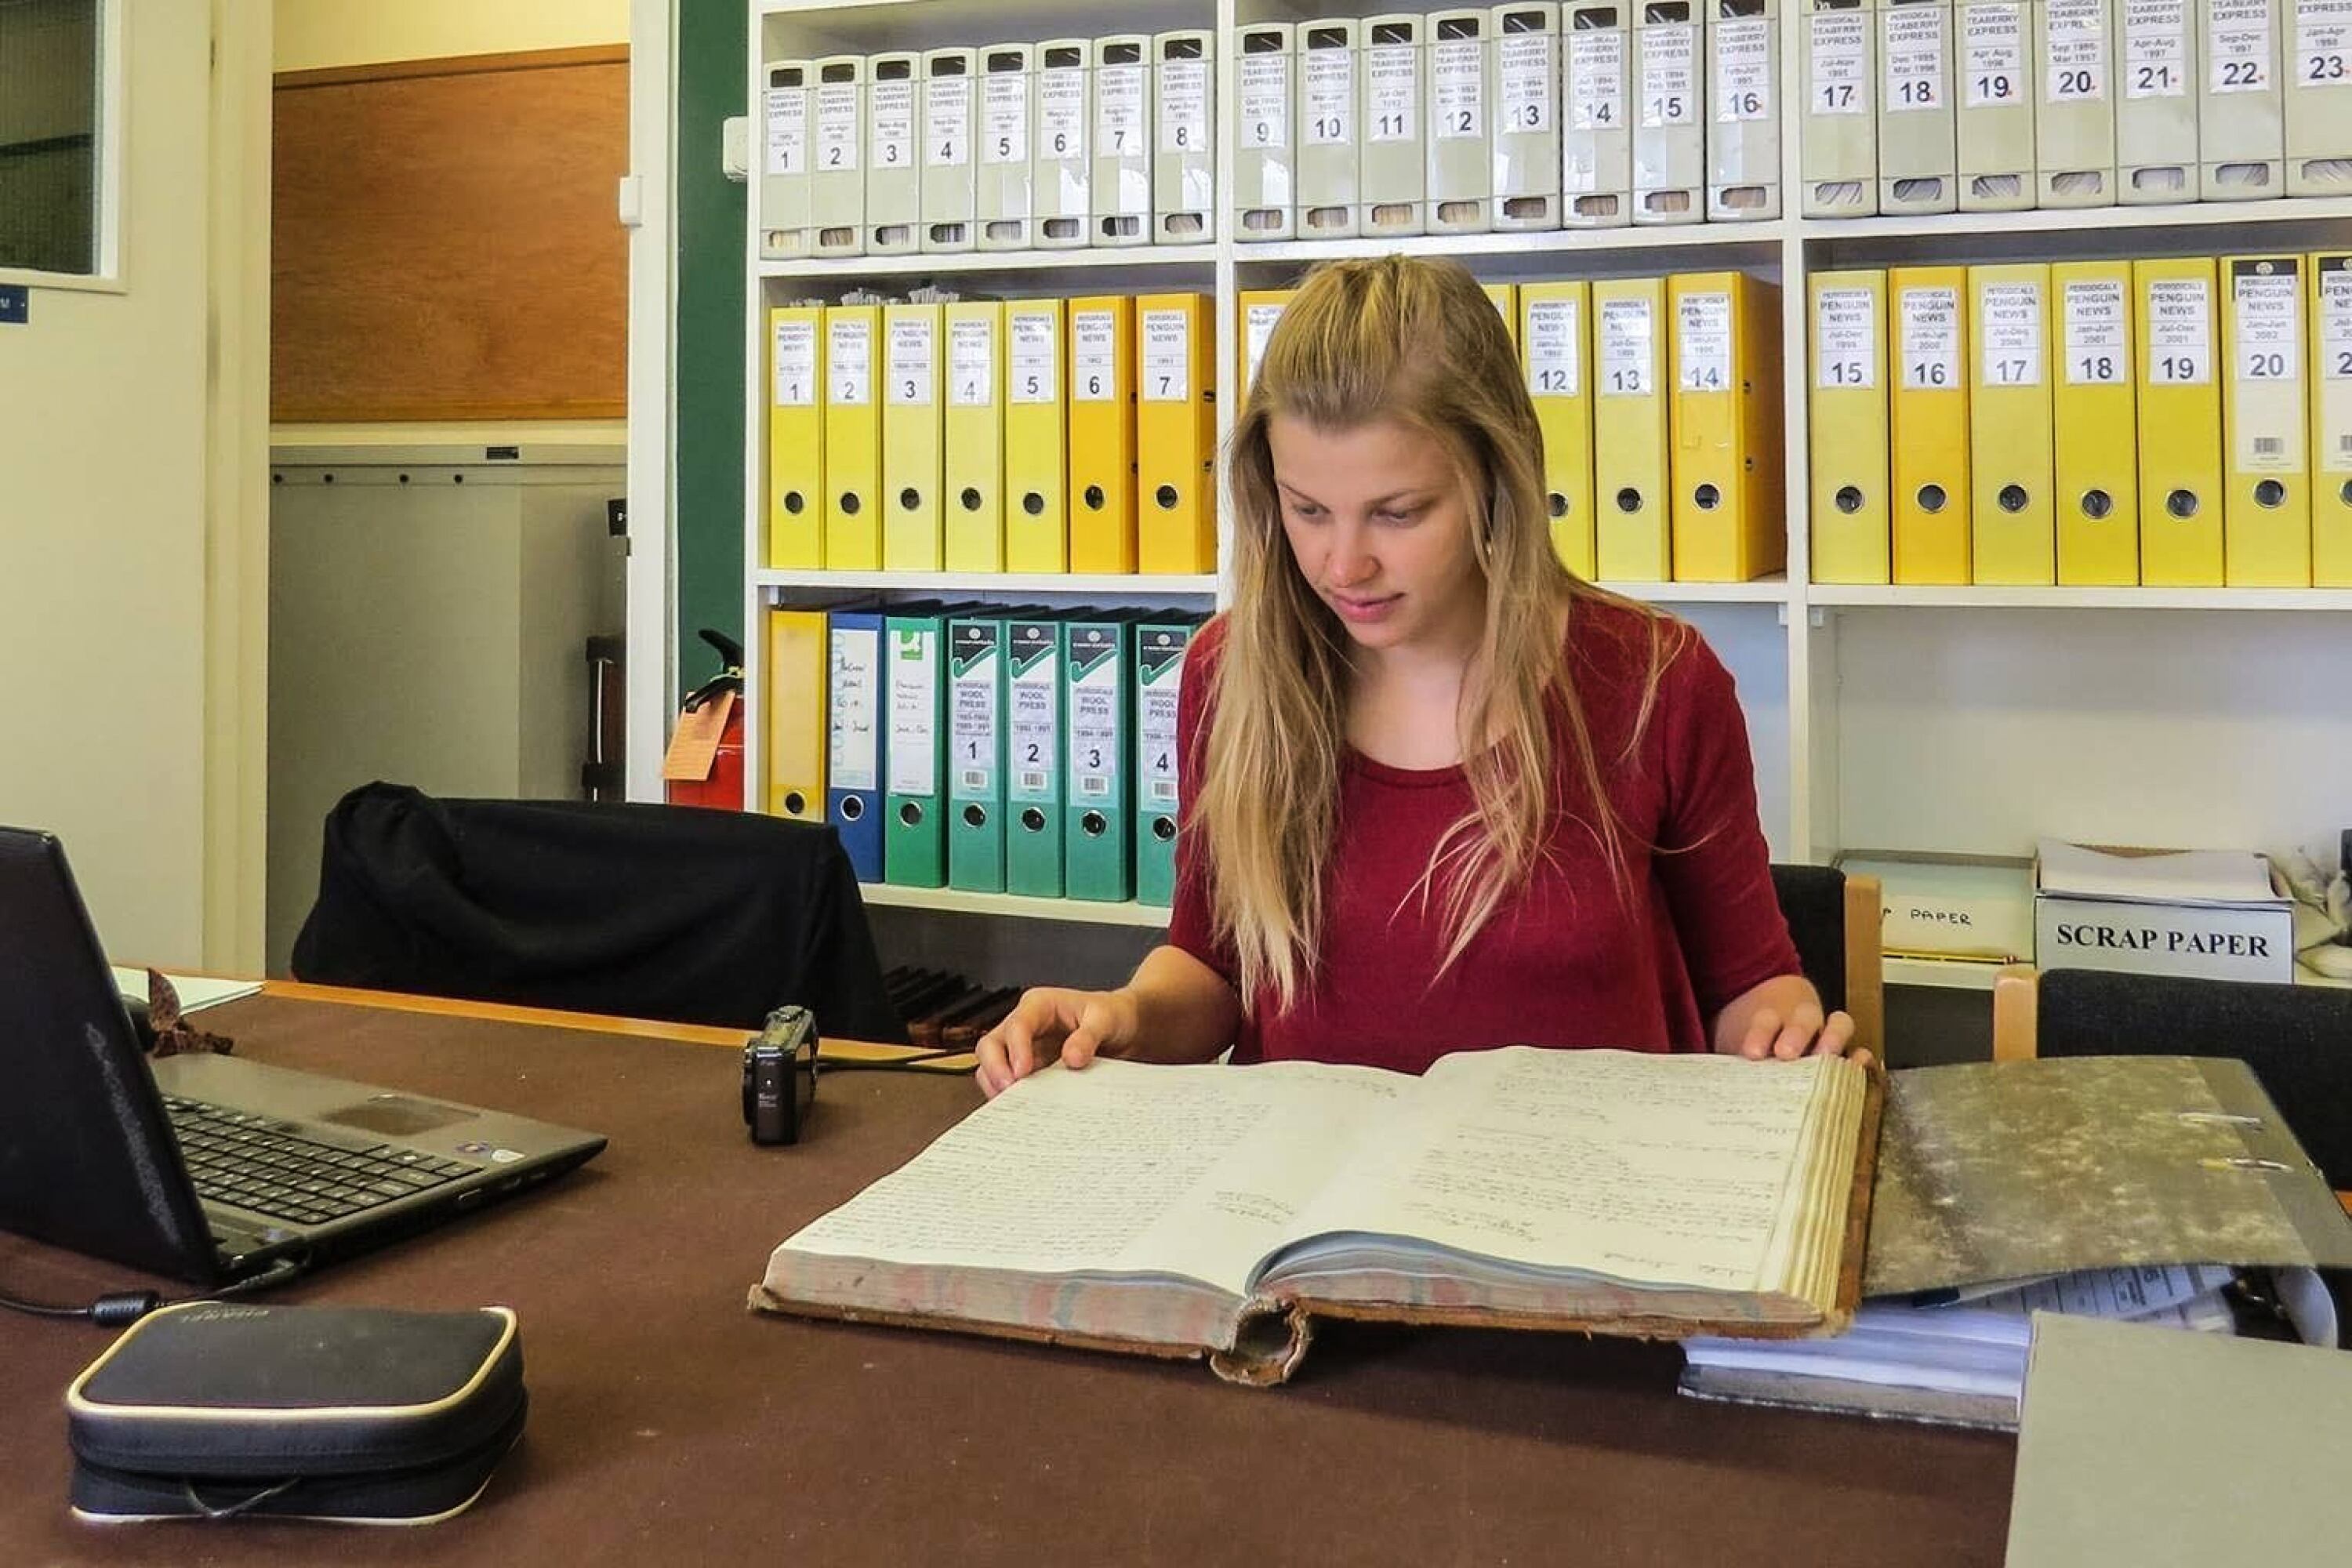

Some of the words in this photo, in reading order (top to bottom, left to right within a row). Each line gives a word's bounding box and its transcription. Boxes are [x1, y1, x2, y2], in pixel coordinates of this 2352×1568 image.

[2127, 4, 2180, 14] TEABERRY
[2213, 9, 2267, 20] EXPRESS
[2298, 2, 2352, 14] EXPRESS
[1889, 20, 1940, 31] TEABERRY
[1968, 15, 2018, 25] TEABERRY
[2128, 14, 2181, 26] EXPRESS
[1889, 31, 1938, 42] EXPRESS
[1968, 26, 2017, 37] EXPRESS
[1646, 48, 1690, 58] EXPRESS
[1719, 43, 1764, 54] EXPRESS
[2223, 62, 2258, 85] 22
[2309, 56, 2343, 79] 23
[2058, 70, 2091, 93] 20
[2137, 66, 2168, 89] 21
[1824, 85, 1853, 107] 17
[1900, 81, 1931, 103] 18
[1977, 76, 2009, 98] 19
[1653, 97, 1682, 118] 15
[1730, 93, 1758, 114] 16
[1444, 111, 1472, 132] 12
[1513, 105, 1539, 126] 13
[1585, 103, 1610, 123] 14
[1256, 122, 1269, 142] 9
[1315, 118, 1341, 138] 10
[1378, 114, 1403, 135] 11
[1054, 133, 1066, 152] 6
[1114, 131, 1125, 150] 7
[1176, 127, 1187, 146] 8
[830, 147, 841, 165] 2
[887, 144, 897, 162] 3
[940, 141, 952, 159] 4
[999, 138, 1010, 156] 5
[782, 152, 789, 168] 1
[1985, 296, 2036, 307] PENGUIN
[2067, 293, 2120, 303] PENGUIN
[2151, 292, 2205, 303] PENGUIN
[2238, 288, 2293, 298] PENGUIN
[1820, 300, 1870, 310] PENGUIN
[1903, 300, 1955, 310] PENGUIN
[2076, 307, 2112, 316] NEWS
[2160, 305, 2195, 315] NEWS
[2248, 301, 2285, 311] NEWS
[1828, 313, 1862, 322] NEWS
[1912, 313, 1947, 323] NEWS
[1994, 310, 2028, 319] NEWS
[1146, 323, 1185, 332] PENGUIN
[1831, 361, 1863, 383] 15
[1914, 362, 1946, 385] 16
[1996, 360, 2027, 383] 17
[2082, 357, 2113, 379] 18
[2161, 358, 2194, 379] 19
[2249, 354, 2285, 377] 20
[1026, 376, 1039, 394] 5
[1089, 376, 1100, 394] 6
[1159, 376, 1171, 395] 7
[1539, 370, 1568, 390] 12
[1613, 370, 1640, 391] 13
[1692, 367, 1719, 388] 14
[790, 383, 798, 401] 1
[844, 381, 855, 399] 2
[905, 380, 916, 398] 3
[964, 380, 975, 399] 4
[968, 741, 977, 760] 1
[1028, 743, 1040, 762] 2
[1089, 748, 1102, 768] 3
[1156, 753, 1169, 772] 4
[1910, 908, 1973, 926] PAPER
[2056, 924, 2158, 951] SCRAP
[2166, 930, 2270, 958] PAPER
